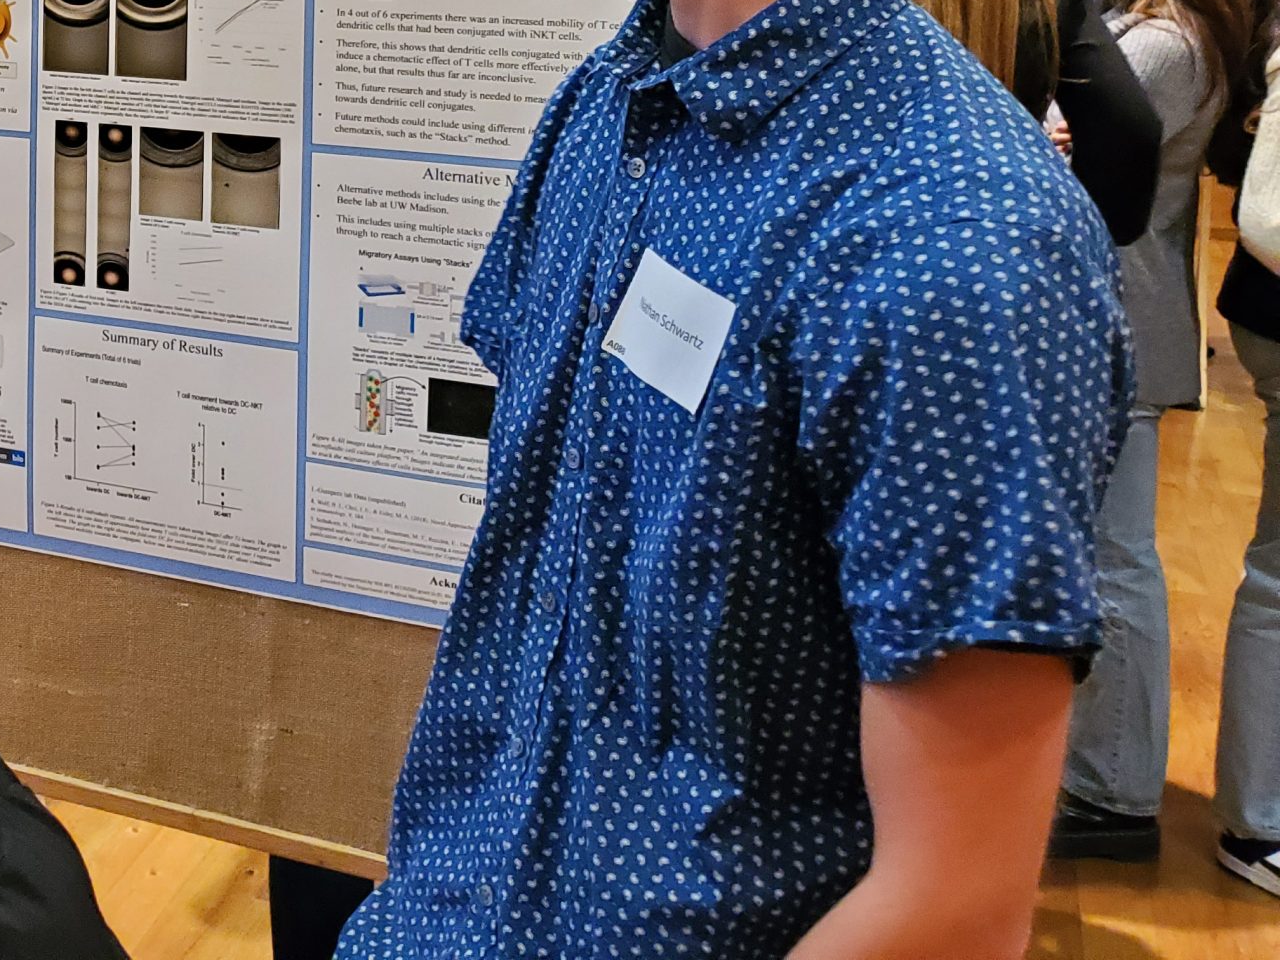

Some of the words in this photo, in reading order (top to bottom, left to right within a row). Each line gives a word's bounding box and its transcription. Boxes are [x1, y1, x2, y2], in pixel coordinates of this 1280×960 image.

[422, 167, 500, 186] Alternative
[336, 195, 362, 206] Beebe
[364, 197, 377, 207] lab
[389, 200, 407, 210] UW
[409, 202, 448, 214] Madison.
[337, 184, 383, 195] Alternative
[385, 189, 420, 198] methods
[423, 191, 458, 202] includes
[461, 196, 484, 207] using
[337, 214, 354, 224] This
[357, 215, 391, 227] includes
[393, 220, 417, 232] using
[418, 223, 454, 235] multiple
[456, 227, 483, 237] stacks
[336, 226, 368, 238] through
[380, 232, 403, 241] reach
[412, 234, 464, 247] chemotactic
[358, 249, 392, 260] Migratory
[393, 253, 419, 263] Assays
[420, 256, 441, 266] Using
[443, 258, 472, 268] "Stacks"
[660, 314, 704, 350] Schwartz
[102, 330, 158, 350] Summary
[162, 338, 176, 350] of
[178, 340, 224, 357] Results
[99, 379, 127, 388] chemotaxis
[191, 394, 217, 403] movement
[218, 397, 239, 406] towards
[240, 400, 262, 410] DC-NKT
